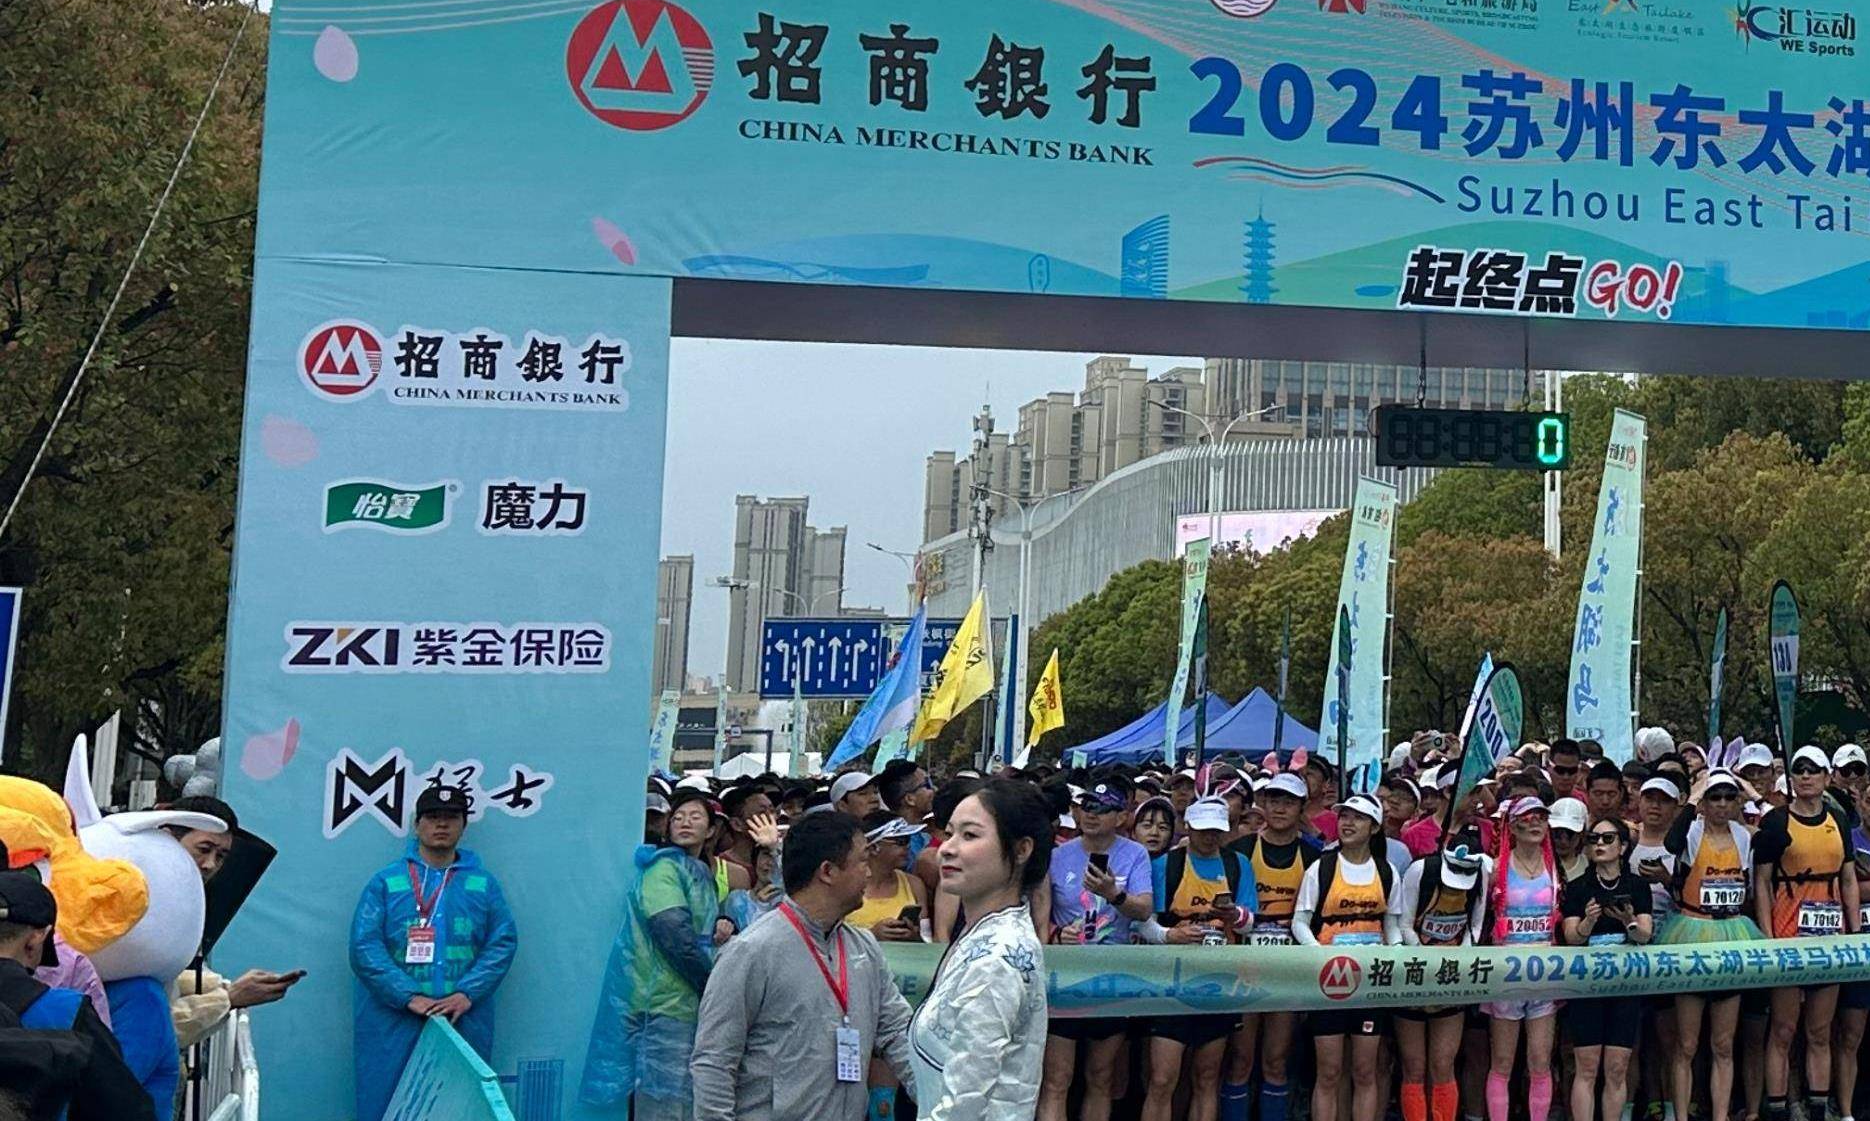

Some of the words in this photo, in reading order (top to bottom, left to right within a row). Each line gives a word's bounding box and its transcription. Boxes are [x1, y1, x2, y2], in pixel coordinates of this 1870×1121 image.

[1778, 7, 1857, 41] 汇运动
[1779, 38, 1804, 53] WE
[1808, 40, 1856, 58] Sports
[738, 12, 1157, 128] 招商銀行
[738, 119, 846, 145] CHINA
[855, 126, 1060, 161] MERCHANTS
[1068, 141, 1155, 167] BANK
[1457, 178, 1640, 223] Suzhou
[1665, 188, 1764, 230] East
[1786, 193, 1852, 233] Tai
[1400, 247, 1584, 315] 起终点
[1585, 261, 1686, 319] GO!
[393, 330, 625, 385] 招商銀行
[394, 386, 451, 401] CHINA
[456, 388, 569, 404] MERCHANTS
[573, 392, 622, 406] BANK
[481, 482, 587, 531] 魔力
[288, 627, 401, 666] ZKI
[412, 627, 605, 667] 紫金保险
[1702, 891, 1711, 904] A
[1801, 912, 1810, 926] A
[1367, 957, 1495, 987] 招商銀行
